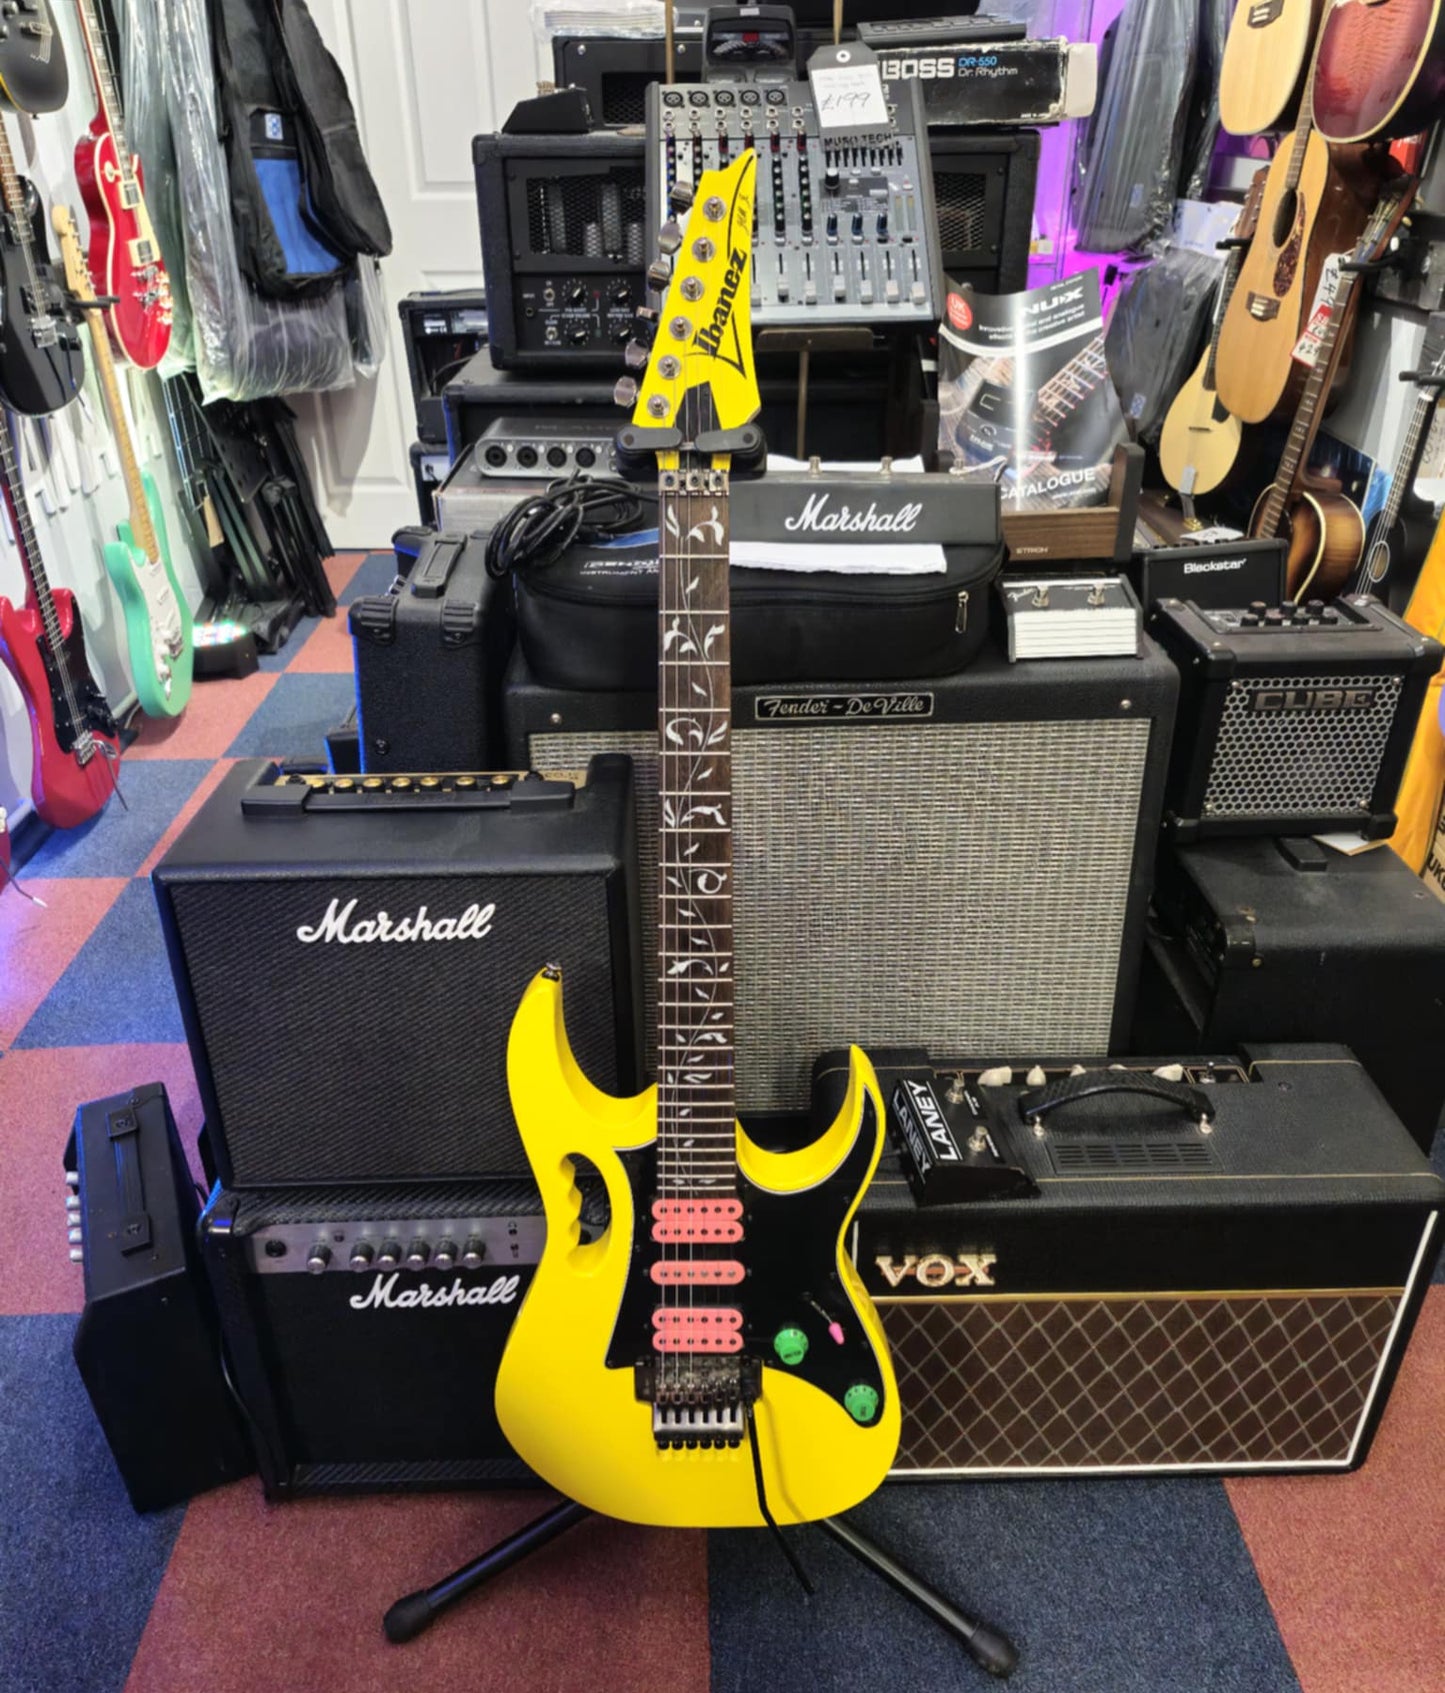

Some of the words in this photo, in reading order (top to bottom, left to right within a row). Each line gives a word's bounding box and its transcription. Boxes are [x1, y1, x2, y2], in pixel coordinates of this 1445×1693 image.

[882, 57, 955, 80] BOSS
[958, 56, 997, 67] DR-550
[958, 68, 974, 77] Dr.
[975, 66, 1018, 78] Rhythm
[821, 92, 871, 111] £199
[692, 246, 748, 360] Ibanez
[1020, 286, 1084, 316] NUX
[784, 493, 923, 531] Marshall
[1184, 559, 1247, 574] Blackstar
[763, 698, 829, 717] Fender
[1254, 690, 1373, 710] CUBE
[296, 898, 495, 944] Marshall
[893, 1088, 932, 1174] LANEY
[907, 1081, 959, 1160] LANEY
[875, 1253, 997, 1288] VOX
[350, 1272, 520, 1309] Marshall
